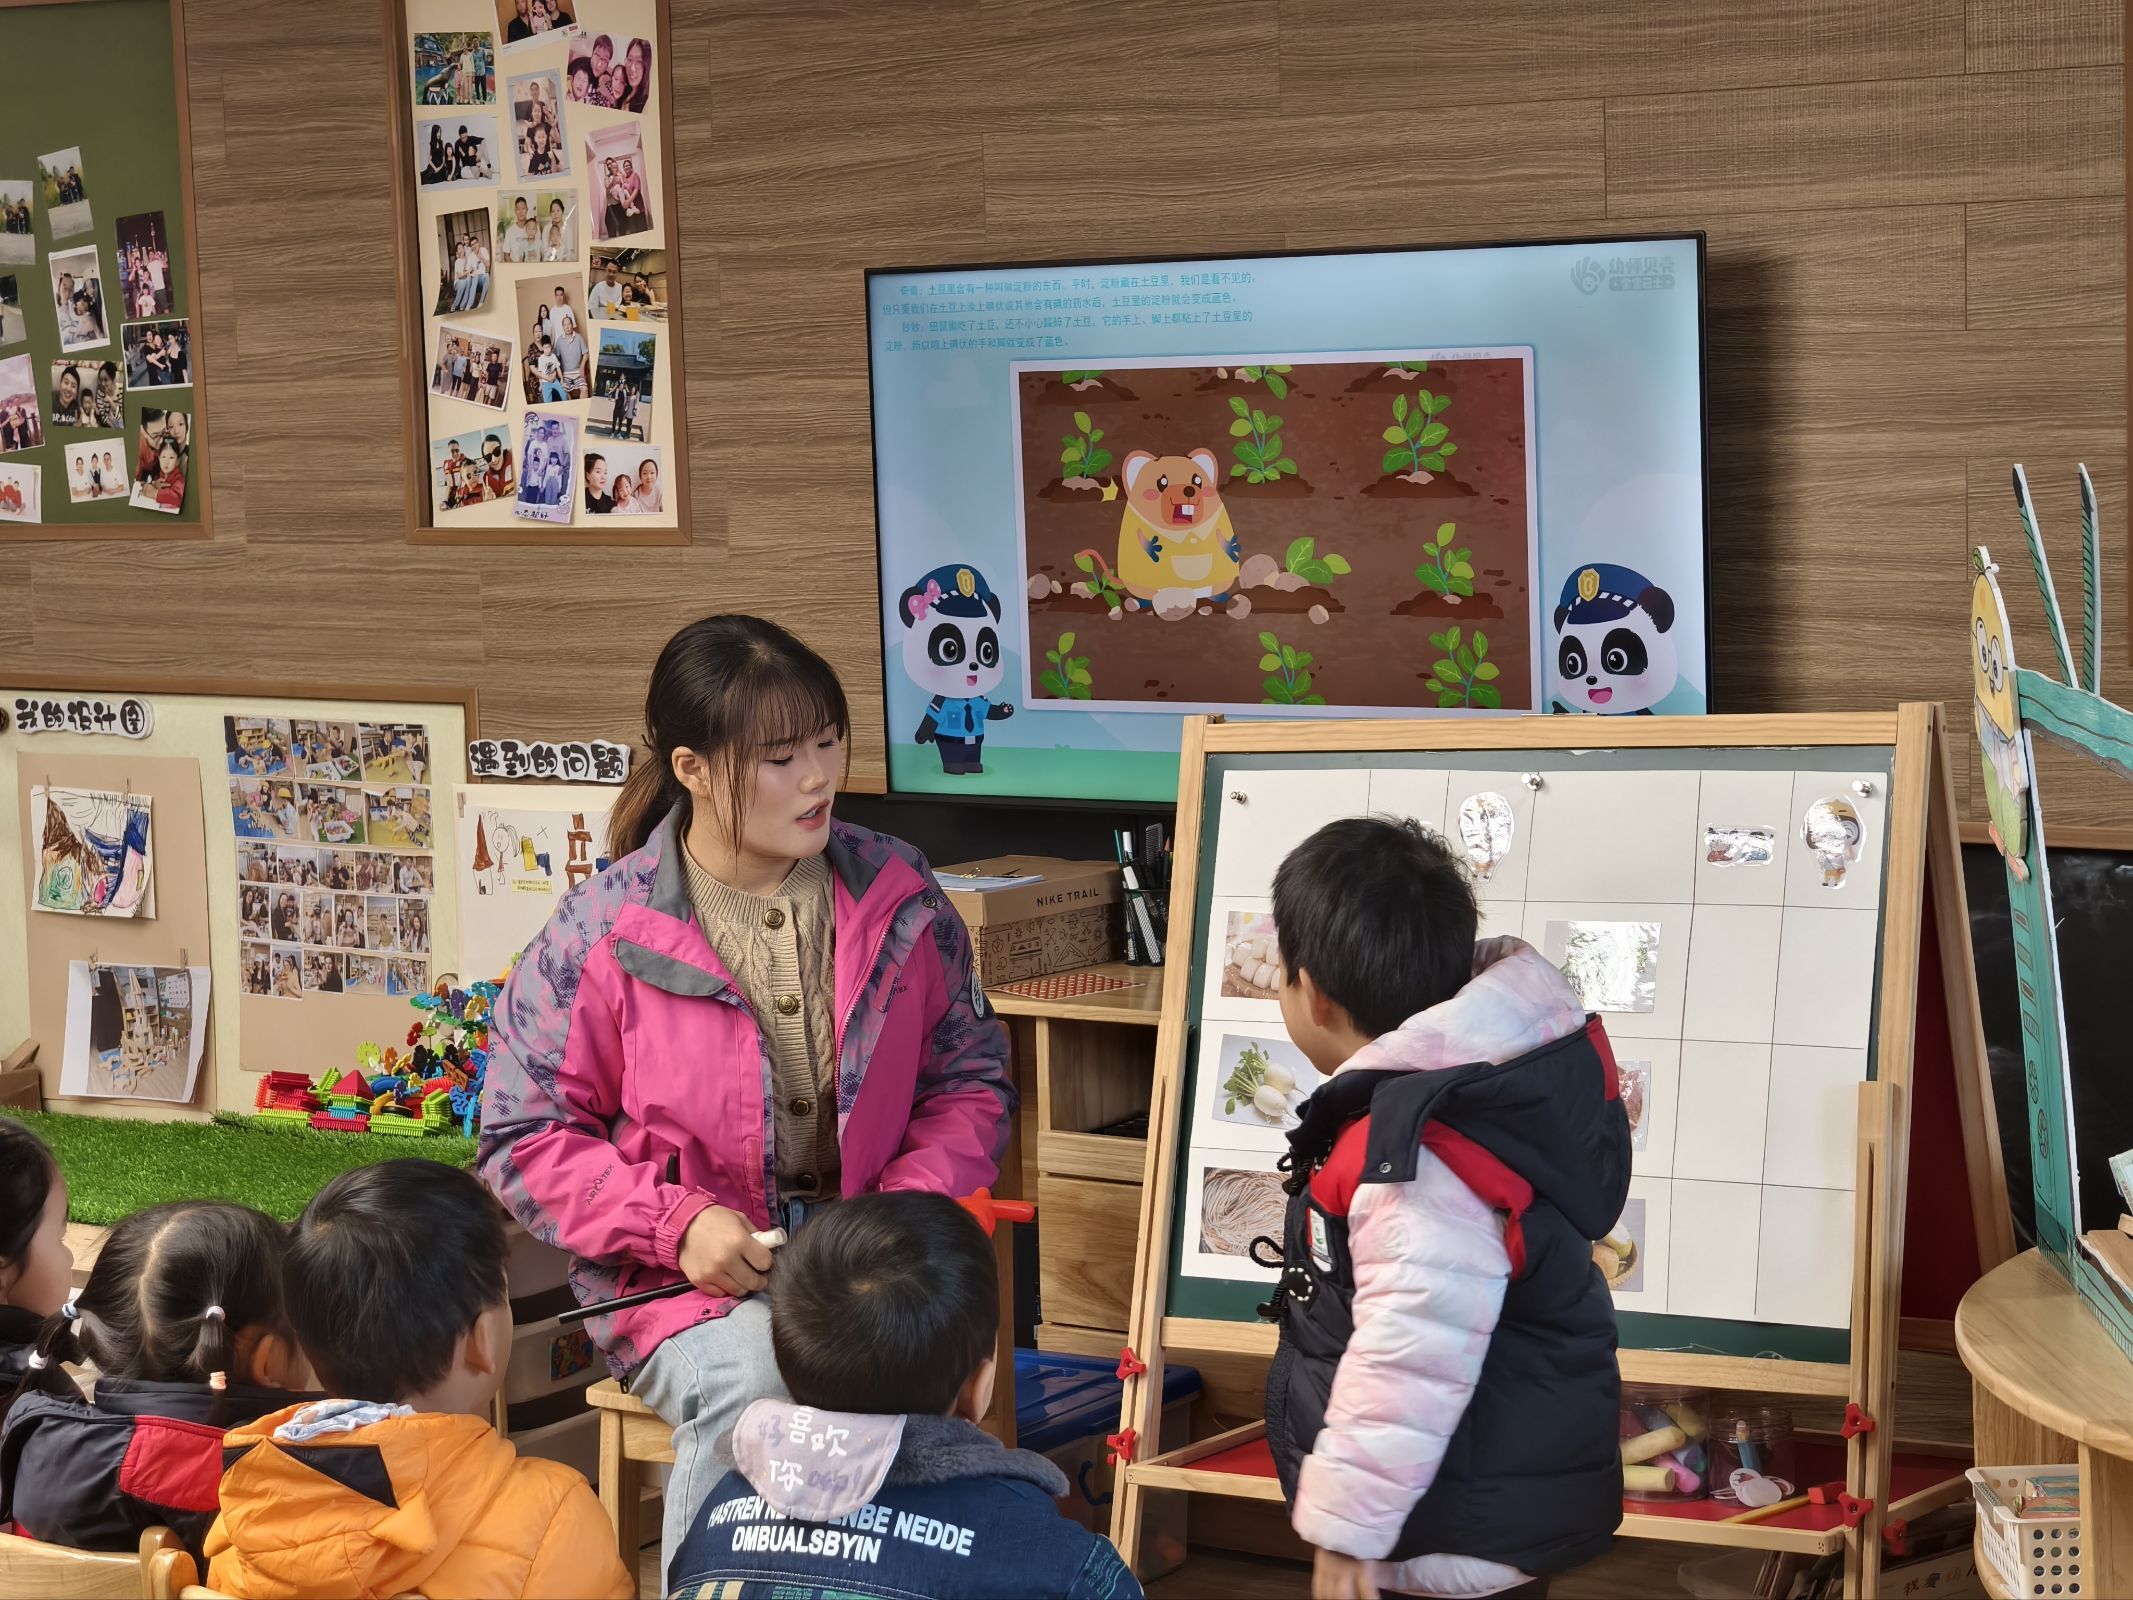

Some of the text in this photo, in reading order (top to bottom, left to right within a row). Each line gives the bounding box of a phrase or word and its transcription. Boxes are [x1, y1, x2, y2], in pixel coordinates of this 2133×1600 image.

[15, 698, 145, 734] 我的设计图
[469, 741, 624, 779] 遇到的问题
[1036, 888, 1100, 908] NIKE TRAIL
[827, 1503, 893, 1534] NBE
[893, 1511, 975, 1556] NEDDE
